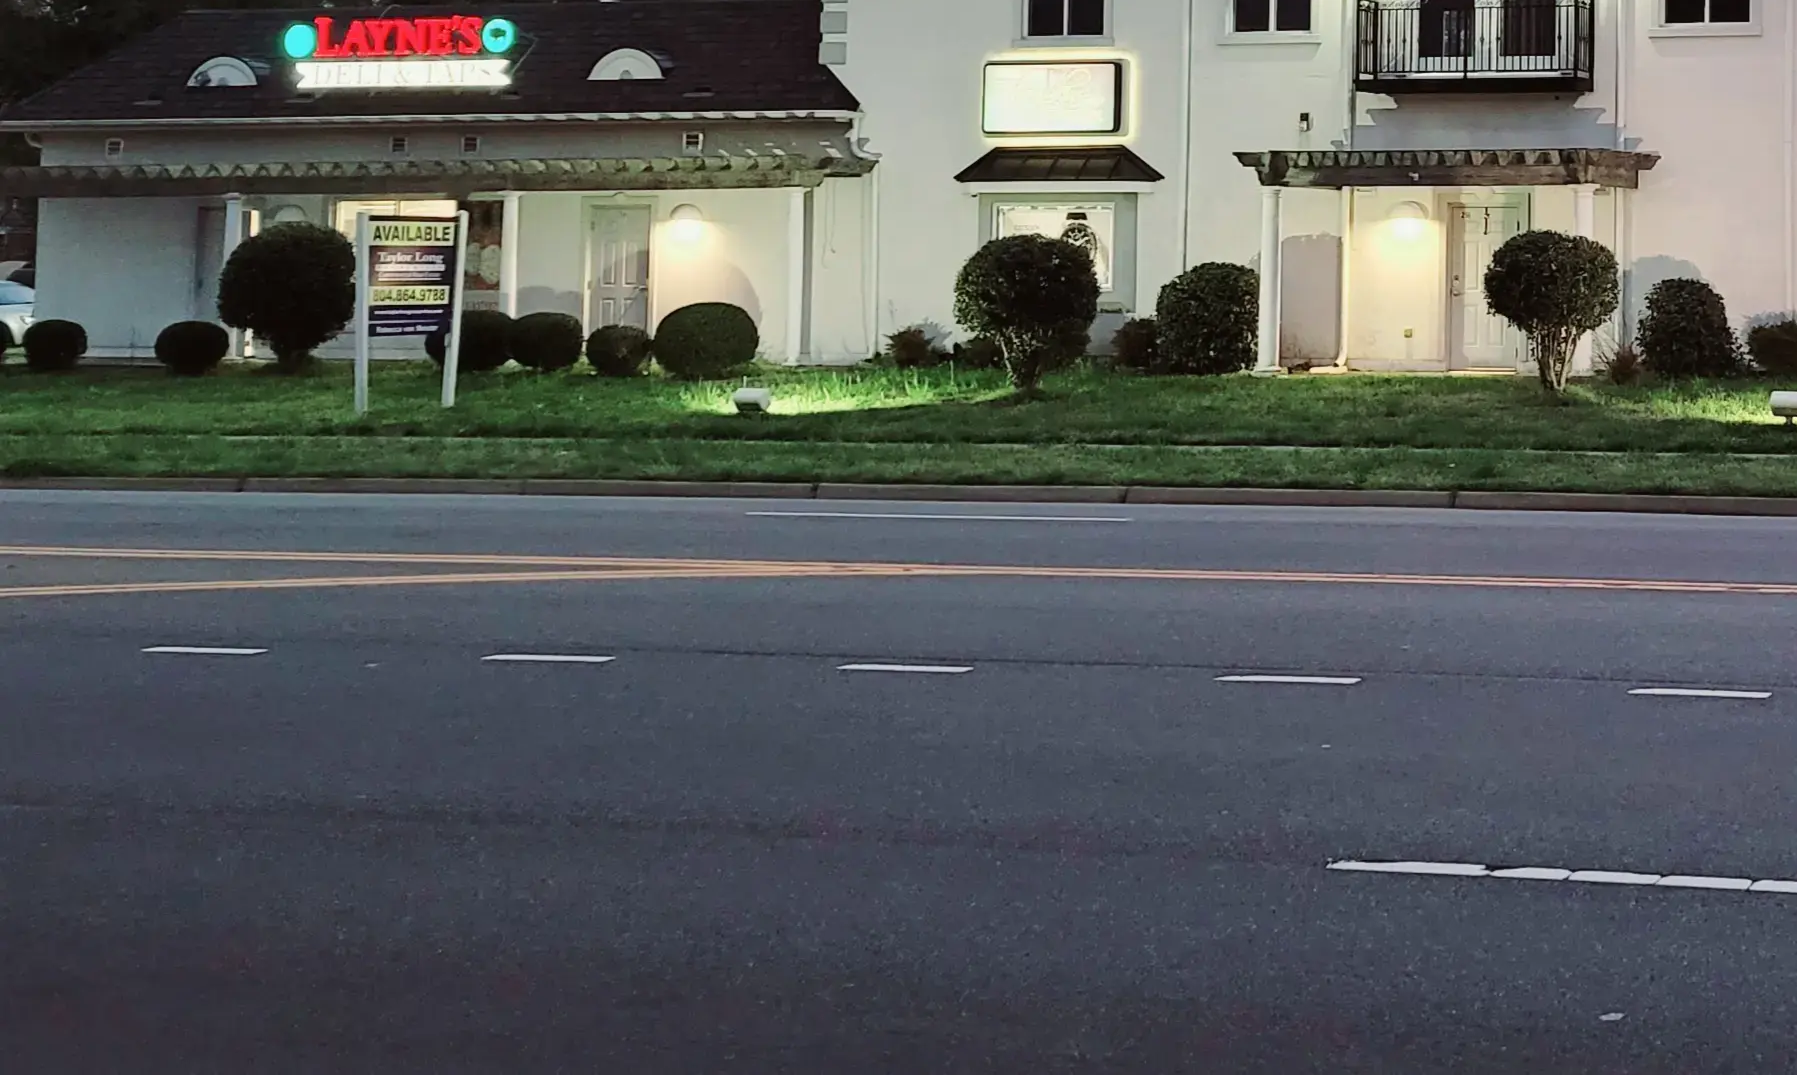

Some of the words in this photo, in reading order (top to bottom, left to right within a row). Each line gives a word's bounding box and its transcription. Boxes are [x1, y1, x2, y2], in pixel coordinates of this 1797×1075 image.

[313, 16, 482, 57] LAYNE'S
[314, 63, 382, 85] DELI
[373, 225, 451, 242] AVAILABLE
[415, 251, 445, 264] Long
